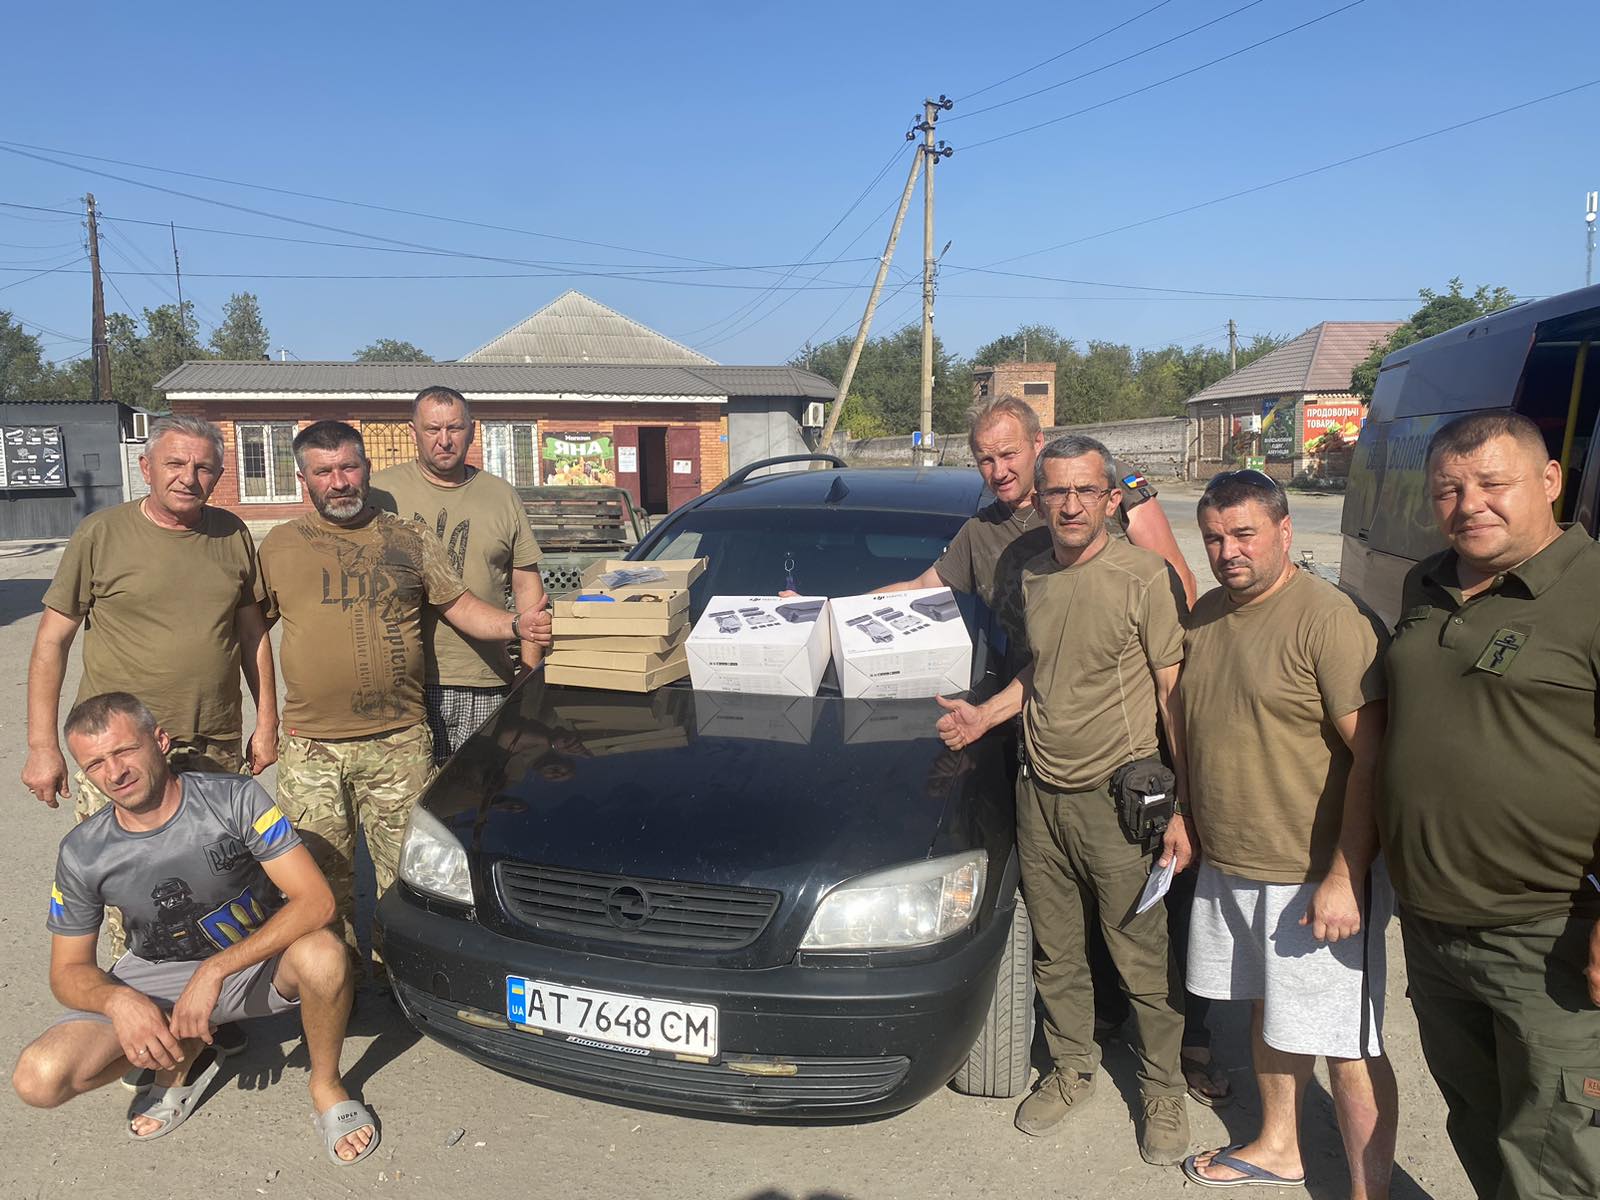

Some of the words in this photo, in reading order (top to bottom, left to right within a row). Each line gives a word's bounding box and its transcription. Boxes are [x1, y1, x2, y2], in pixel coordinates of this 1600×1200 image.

[1306, 407, 1359, 417] ПРОДОВОЛЬЧІ
[1306, 419, 1335, 428] ТОВАРИ
[554, 440, 602, 456] ЯНА
[511, 1004, 524, 1016] UA
[528, 989, 569, 1024] AT
[576, 997, 651, 1039] 7648
[660, 1011, 709, 1047] CM
